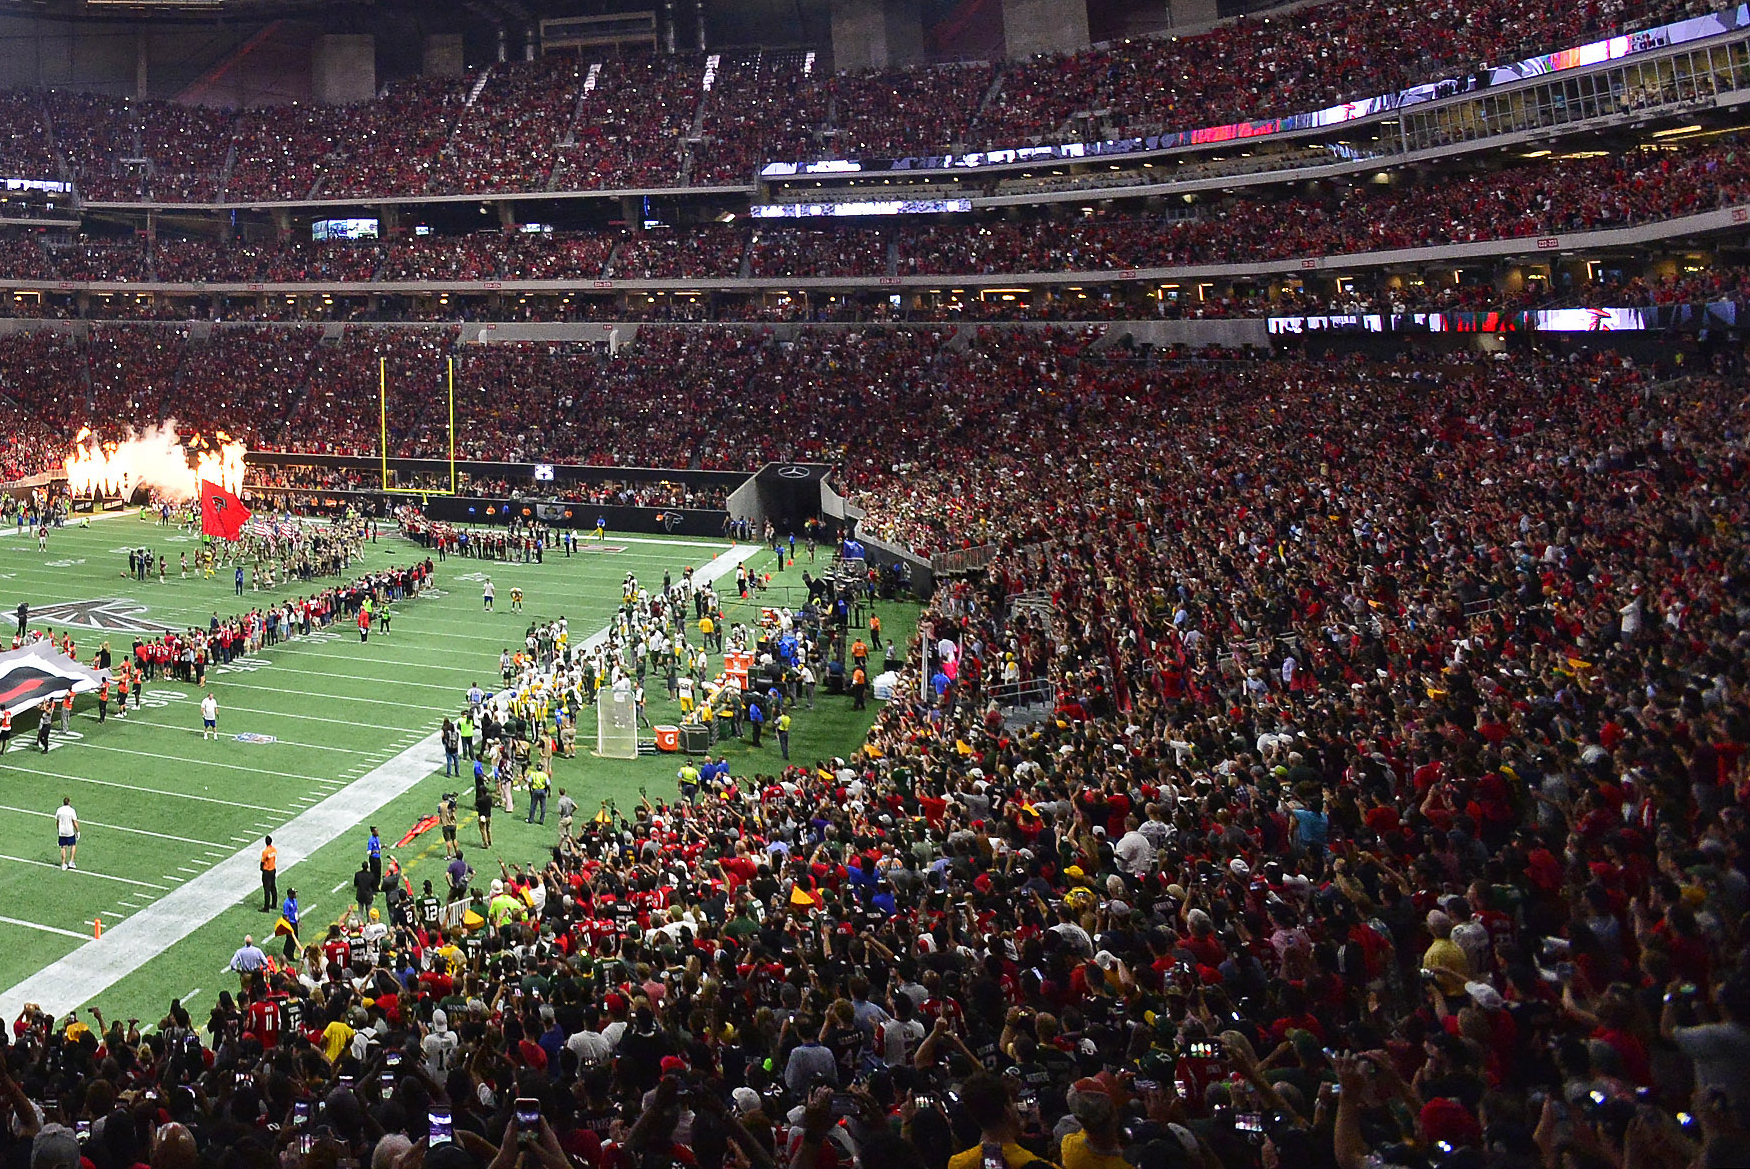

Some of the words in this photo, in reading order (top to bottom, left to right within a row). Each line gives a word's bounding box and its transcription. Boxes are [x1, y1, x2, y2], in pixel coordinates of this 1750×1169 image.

[664, 733, 675, 745] G
[424, 905, 439, 922] 12
[265, 1015, 273, 1031] 11
